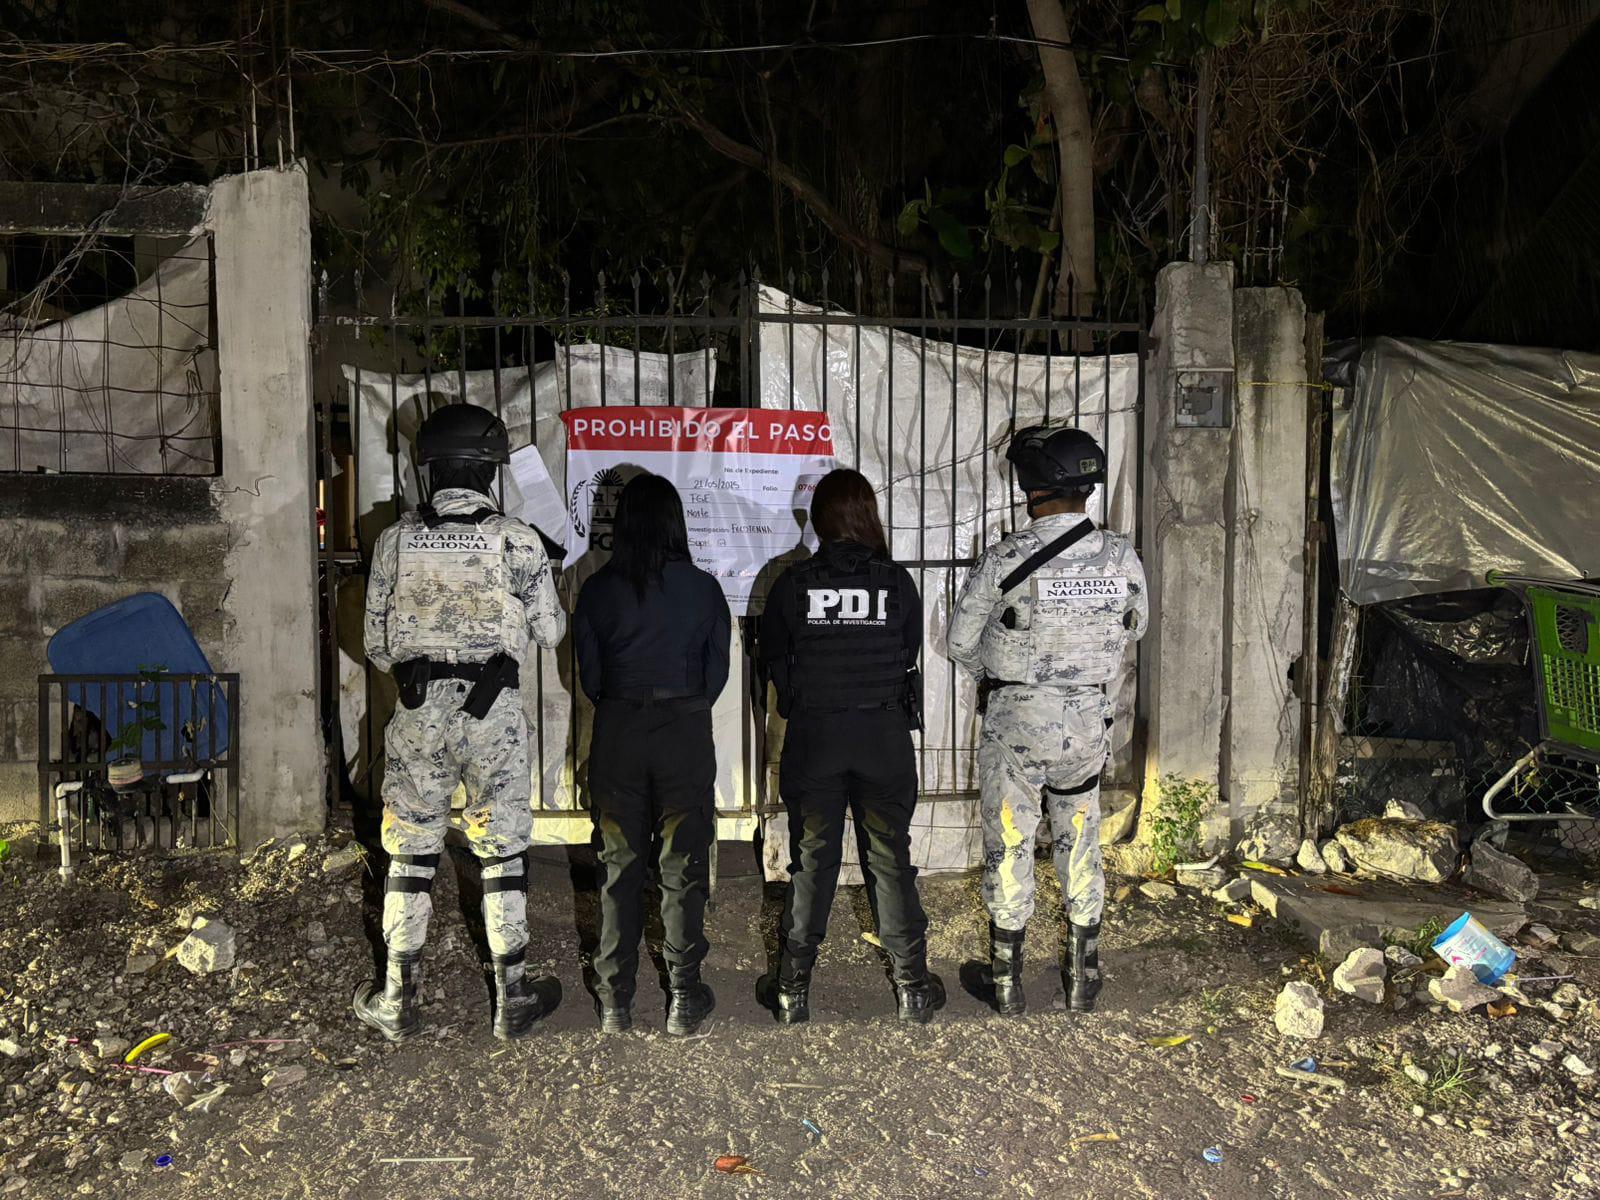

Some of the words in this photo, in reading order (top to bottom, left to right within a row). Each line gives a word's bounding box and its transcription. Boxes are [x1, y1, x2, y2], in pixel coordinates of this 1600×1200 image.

[574, 418, 721, 439] PROHIBIDO
[732, 421, 760, 440] EL
[769, 423, 832, 442] PASO
[414, 534, 486, 542] GUARDIA
[590, 532, 614, 551] FG
[407, 542, 493, 550] NACIONAL
[1052, 580, 1117, 588] GUARDIA
[1047, 588, 1122, 597] NACIONAL
[807, 588, 888, 620] PDI
